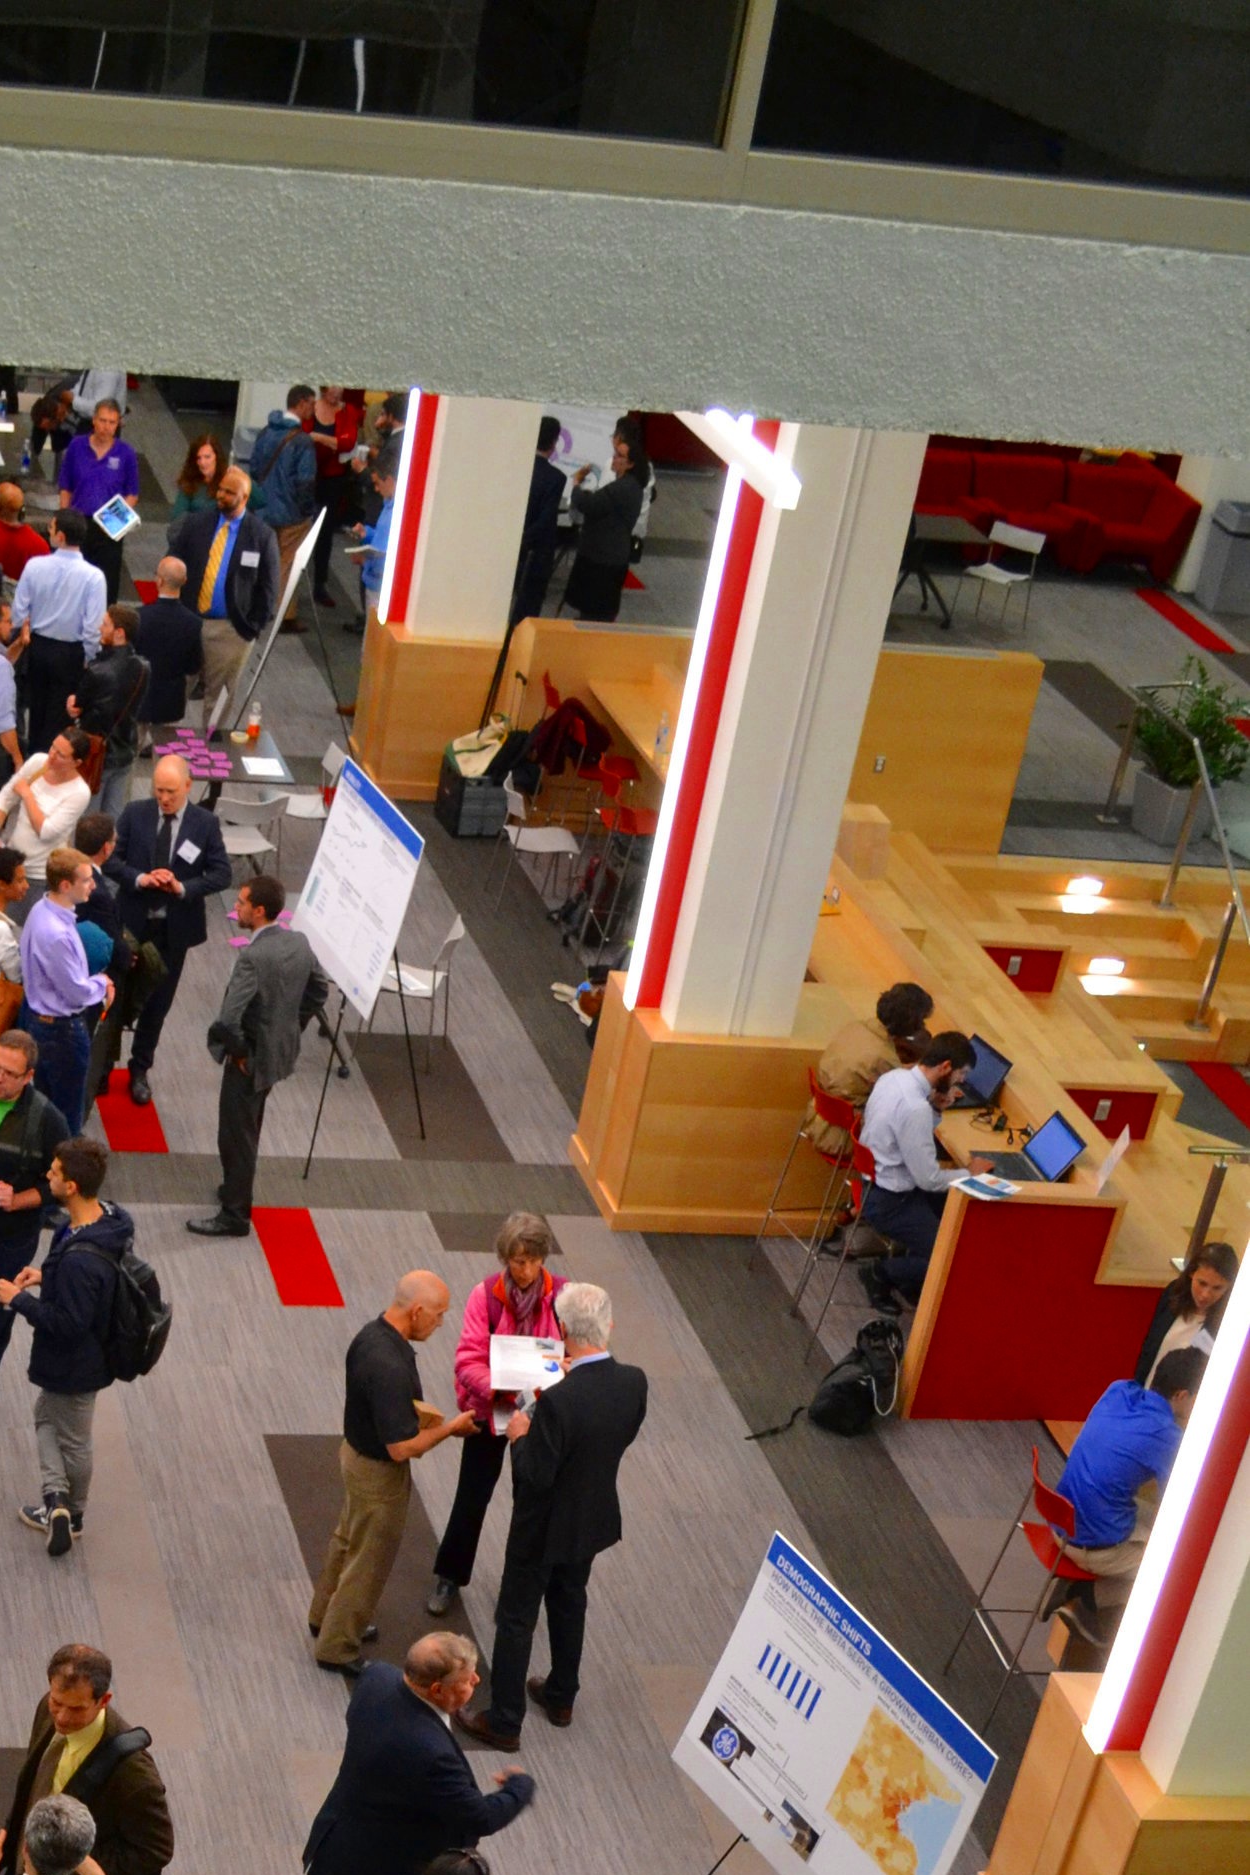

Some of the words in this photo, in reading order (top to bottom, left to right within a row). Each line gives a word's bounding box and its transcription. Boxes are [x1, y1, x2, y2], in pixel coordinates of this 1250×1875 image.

[771, 1569, 790, 1592] HOW
[790, 1588, 809, 1611] WILL
[809, 1609, 826, 1629] THE
[825, 1625, 846, 1649] MBTA
[846, 1646, 872, 1675] SERVE
[878, 1679, 917, 1723] GROWING
[916, 1719, 945, 1753] URBAN
[945, 1750, 973, 1782] CORE?
[776, 1554, 840, 1622] DEMOGRAPHIC
[839, 1619, 872, 1656] SHIFTS
